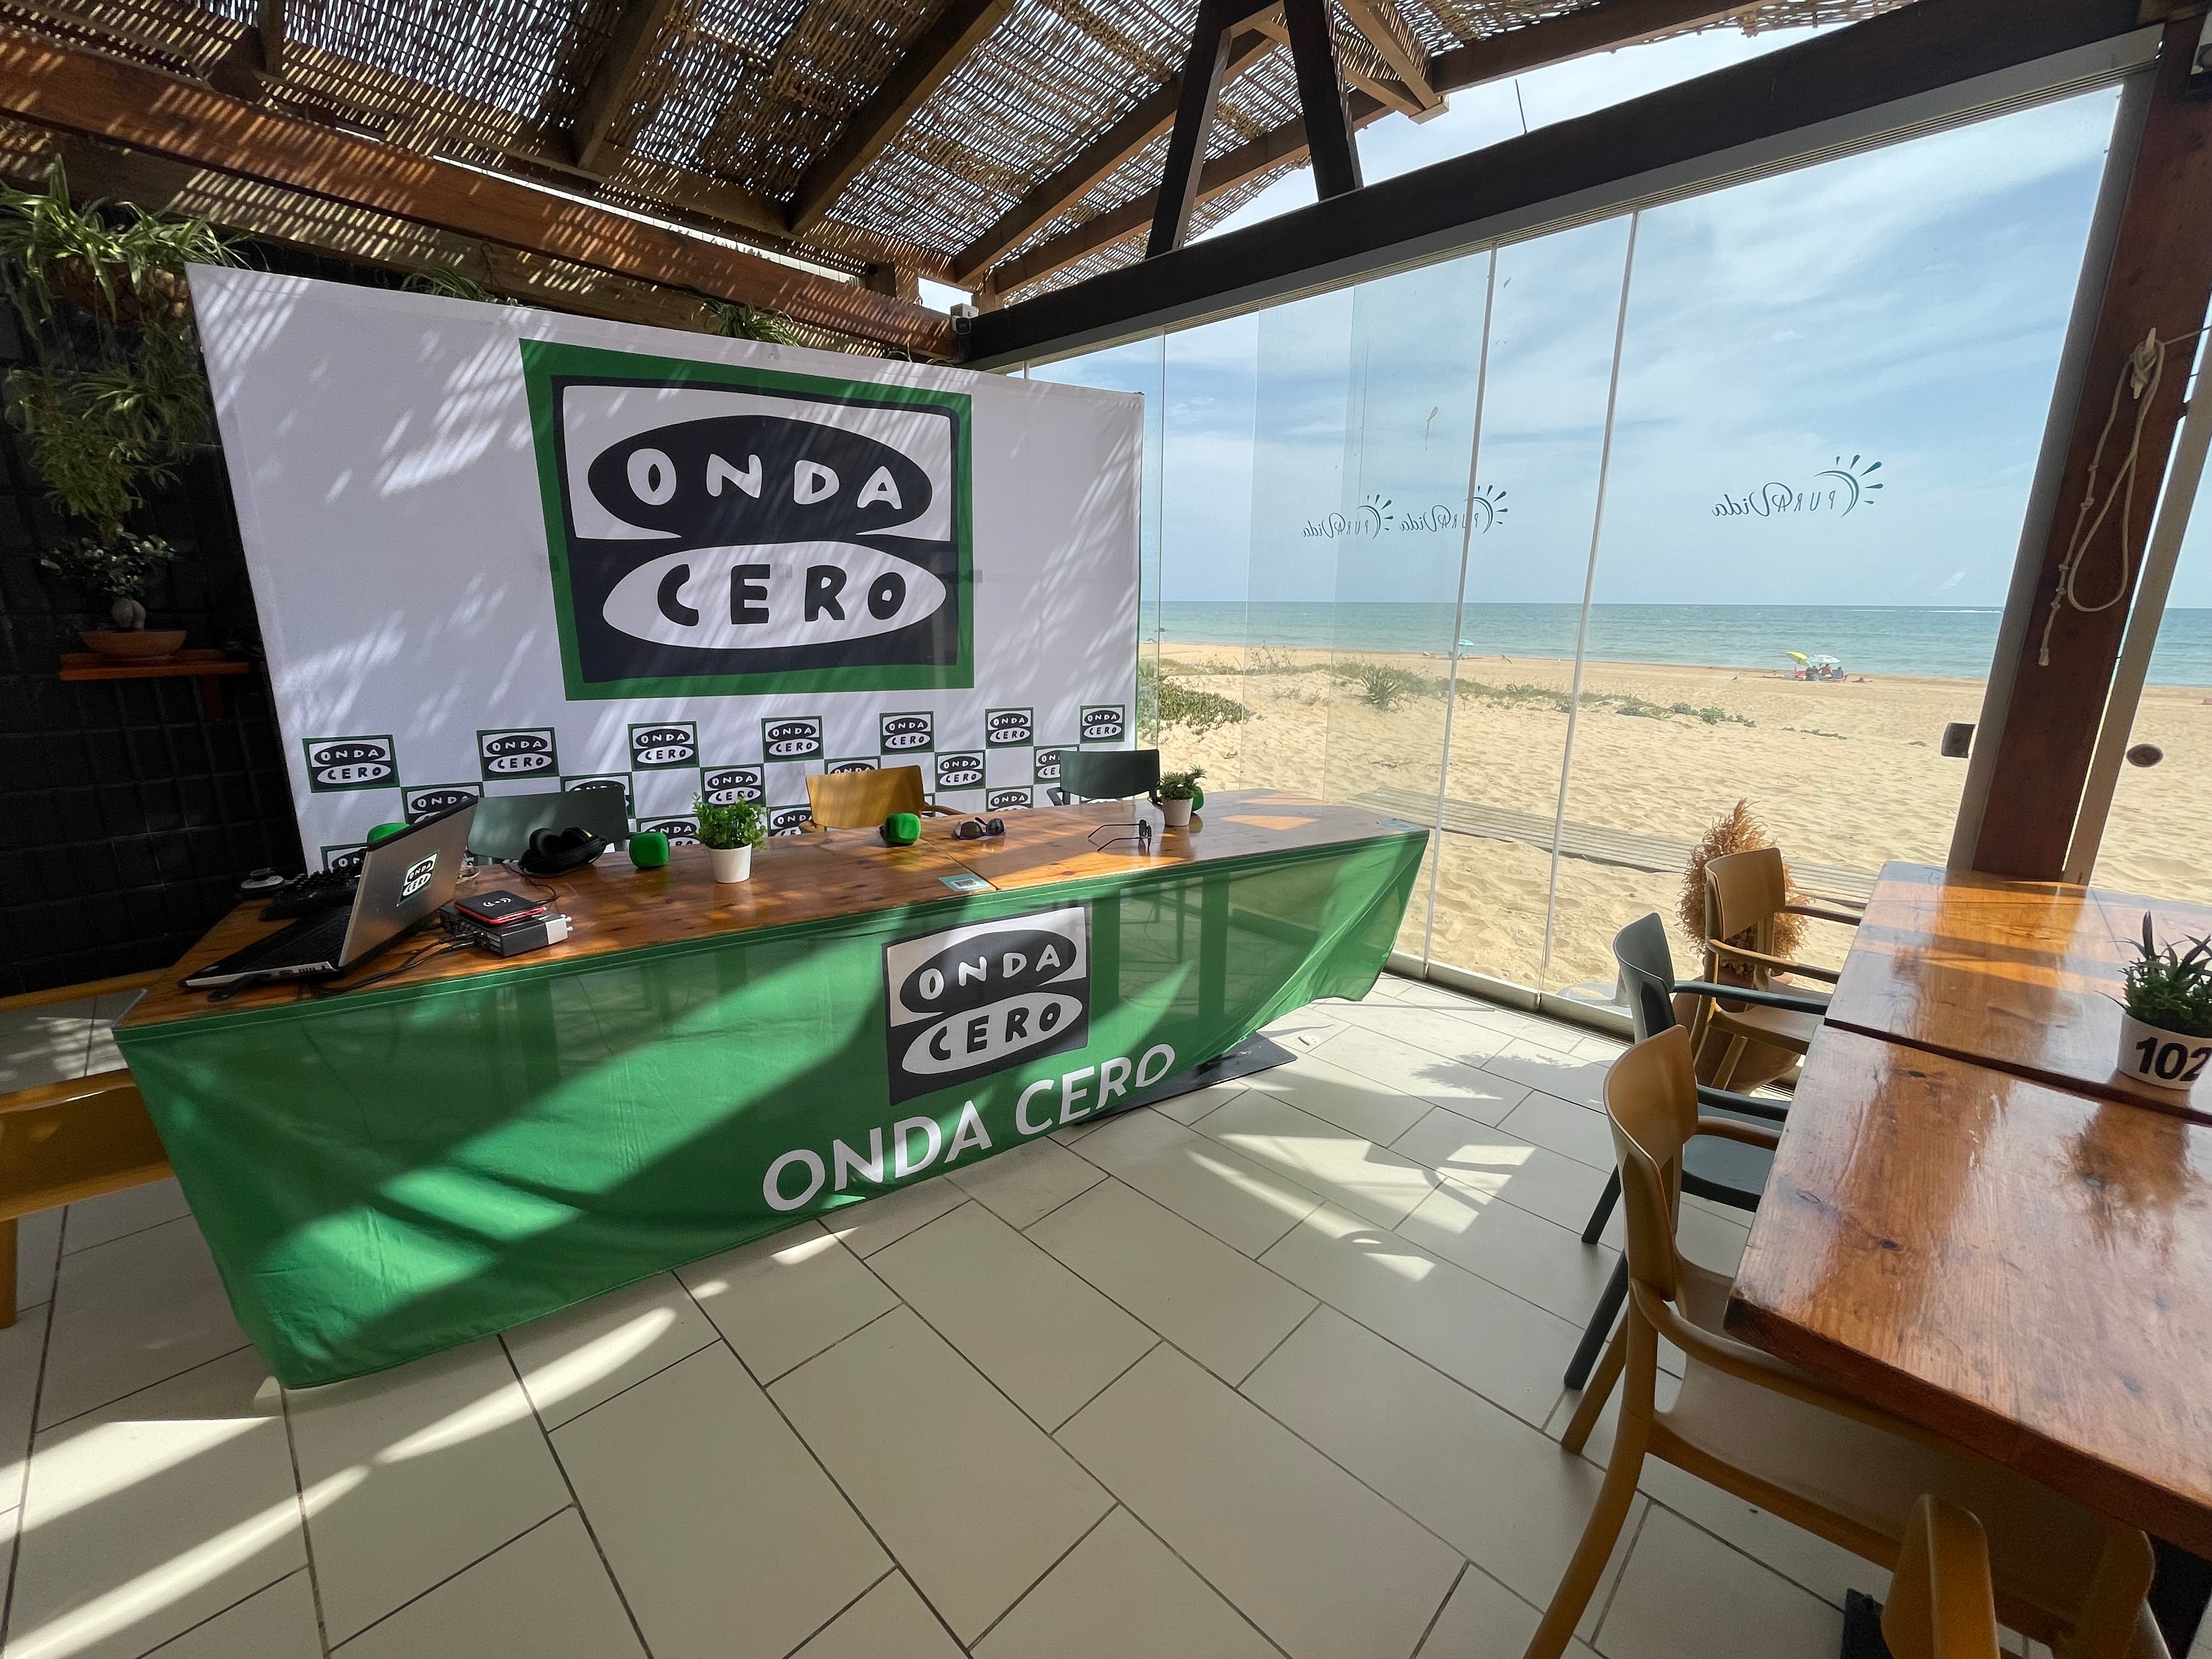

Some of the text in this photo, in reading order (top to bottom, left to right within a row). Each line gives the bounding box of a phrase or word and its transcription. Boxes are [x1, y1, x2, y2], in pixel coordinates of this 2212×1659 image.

[627, 448, 902, 510] ONDA
[657, 563, 906, 627] CERO
[993, 717, 1025, 726] ONDA
[1087, 714, 1117, 722] ONDA
[889, 721, 924, 731] ONDA
[1089, 726, 1117, 735] CERO
[772, 727, 812, 737] ONDA
[995, 731, 1025, 740] CERO
[641, 733, 685, 744] ONDA
[891, 736, 924, 746] CERO
[492, 740, 543, 752] ONDA
[776, 742, 812, 753] CERO
[320, 749, 379, 761] ONDA
[645, 749, 686, 760] CERO
[497, 757, 544, 769] CERO
[943, 760, 977, 769] ONDA
[328, 766, 382, 780] CERO
[946, 773, 977, 783] CERO
[712, 775, 753, 786] ONDA
[715, 790, 754, 802] CERO
[994, 795, 1025, 804] ONDA
[409, 862, 431, 879] ONDA
[407, 875, 428, 893] CERO
[918, 943, 1062, 1001] ONDA
[928, 1002, 1062, 1061] CERO
[2135, 1037, 2212, 1082] 102
[763, 1043, 1176, 1211] ONDA CERO
